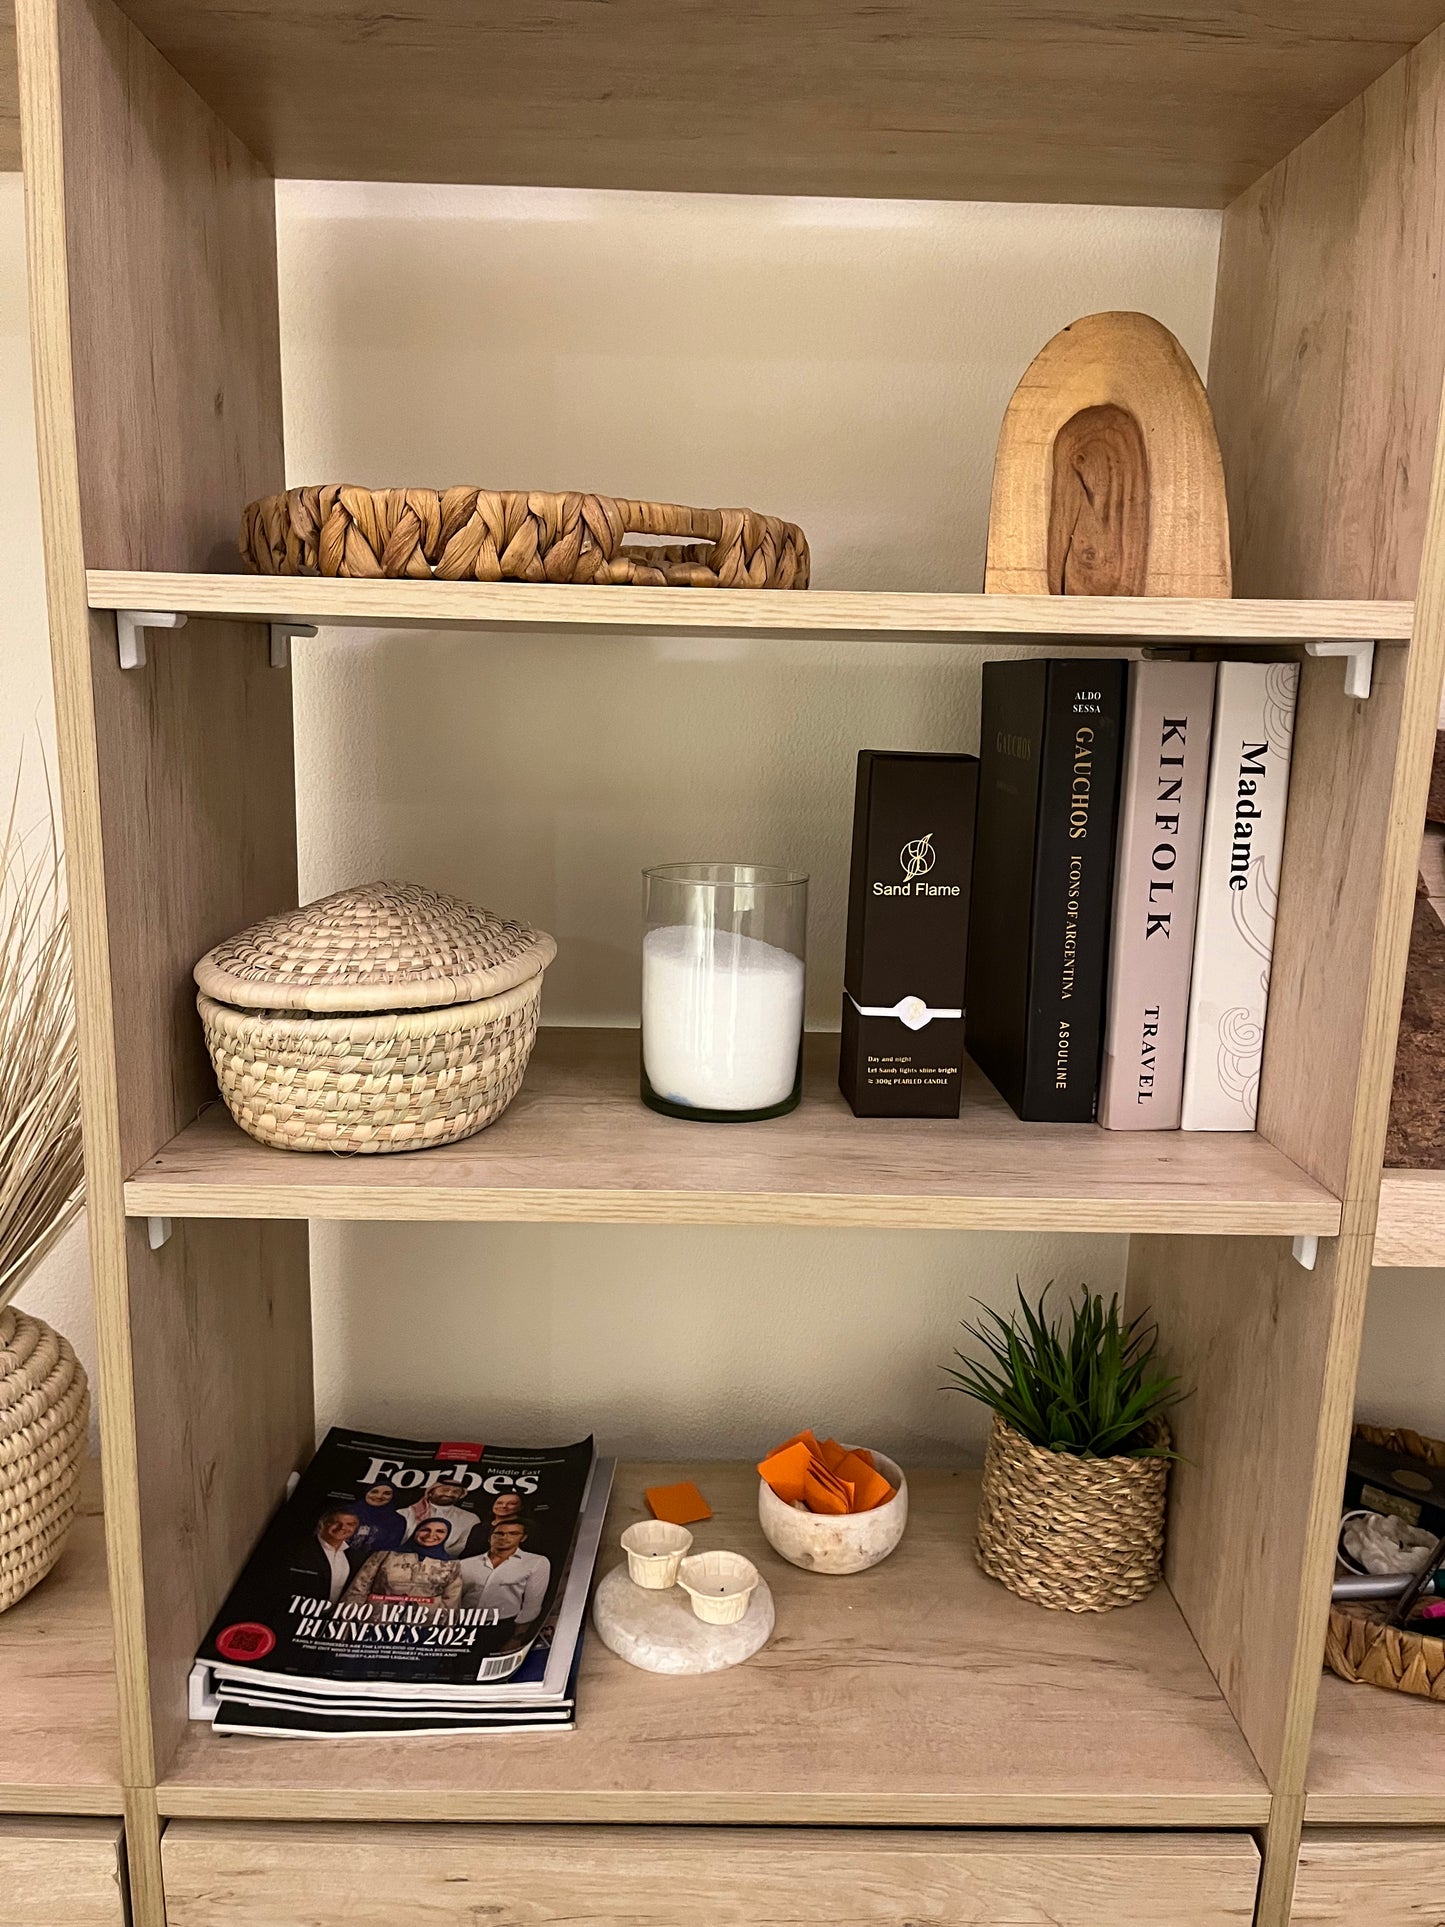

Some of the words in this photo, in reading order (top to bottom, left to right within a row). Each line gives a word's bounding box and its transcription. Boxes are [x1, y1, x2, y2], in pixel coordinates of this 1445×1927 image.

[1072, 704, 1101, 714] SESSA
[1074, 691, 1102, 701] ALDO
[1068, 727, 1095, 839] GAUCHOS
[1145, 716, 1188, 941] KINFOLK
[1229, 740, 1269, 892] Madame
[872, 882, 911, 896] Sand
[915, 882, 960, 896] Flame
[1067, 855, 1082, 898] ICONS
[1066, 900, 1079, 919] OF
[1061, 920, 1077, 1000] ARGENTINA
[1055, 1021, 1071, 1090] ASOULINE
[1137, 1005, 1160, 1105] TRAVEL
[356, 1456, 540, 1495] Forbes
[487, 1467, 520, 1476] Middle
[288, 1595, 332, 1618] TOP
[332, 1601, 374, 1621] 100
[380, 1604, 429, 1624] ARAB
[432, 1608, 500, 1626] FAMILY
[295, 1617, 423, 1644] BUSINESSES
[423, 1627, 478, 1646] 2024
